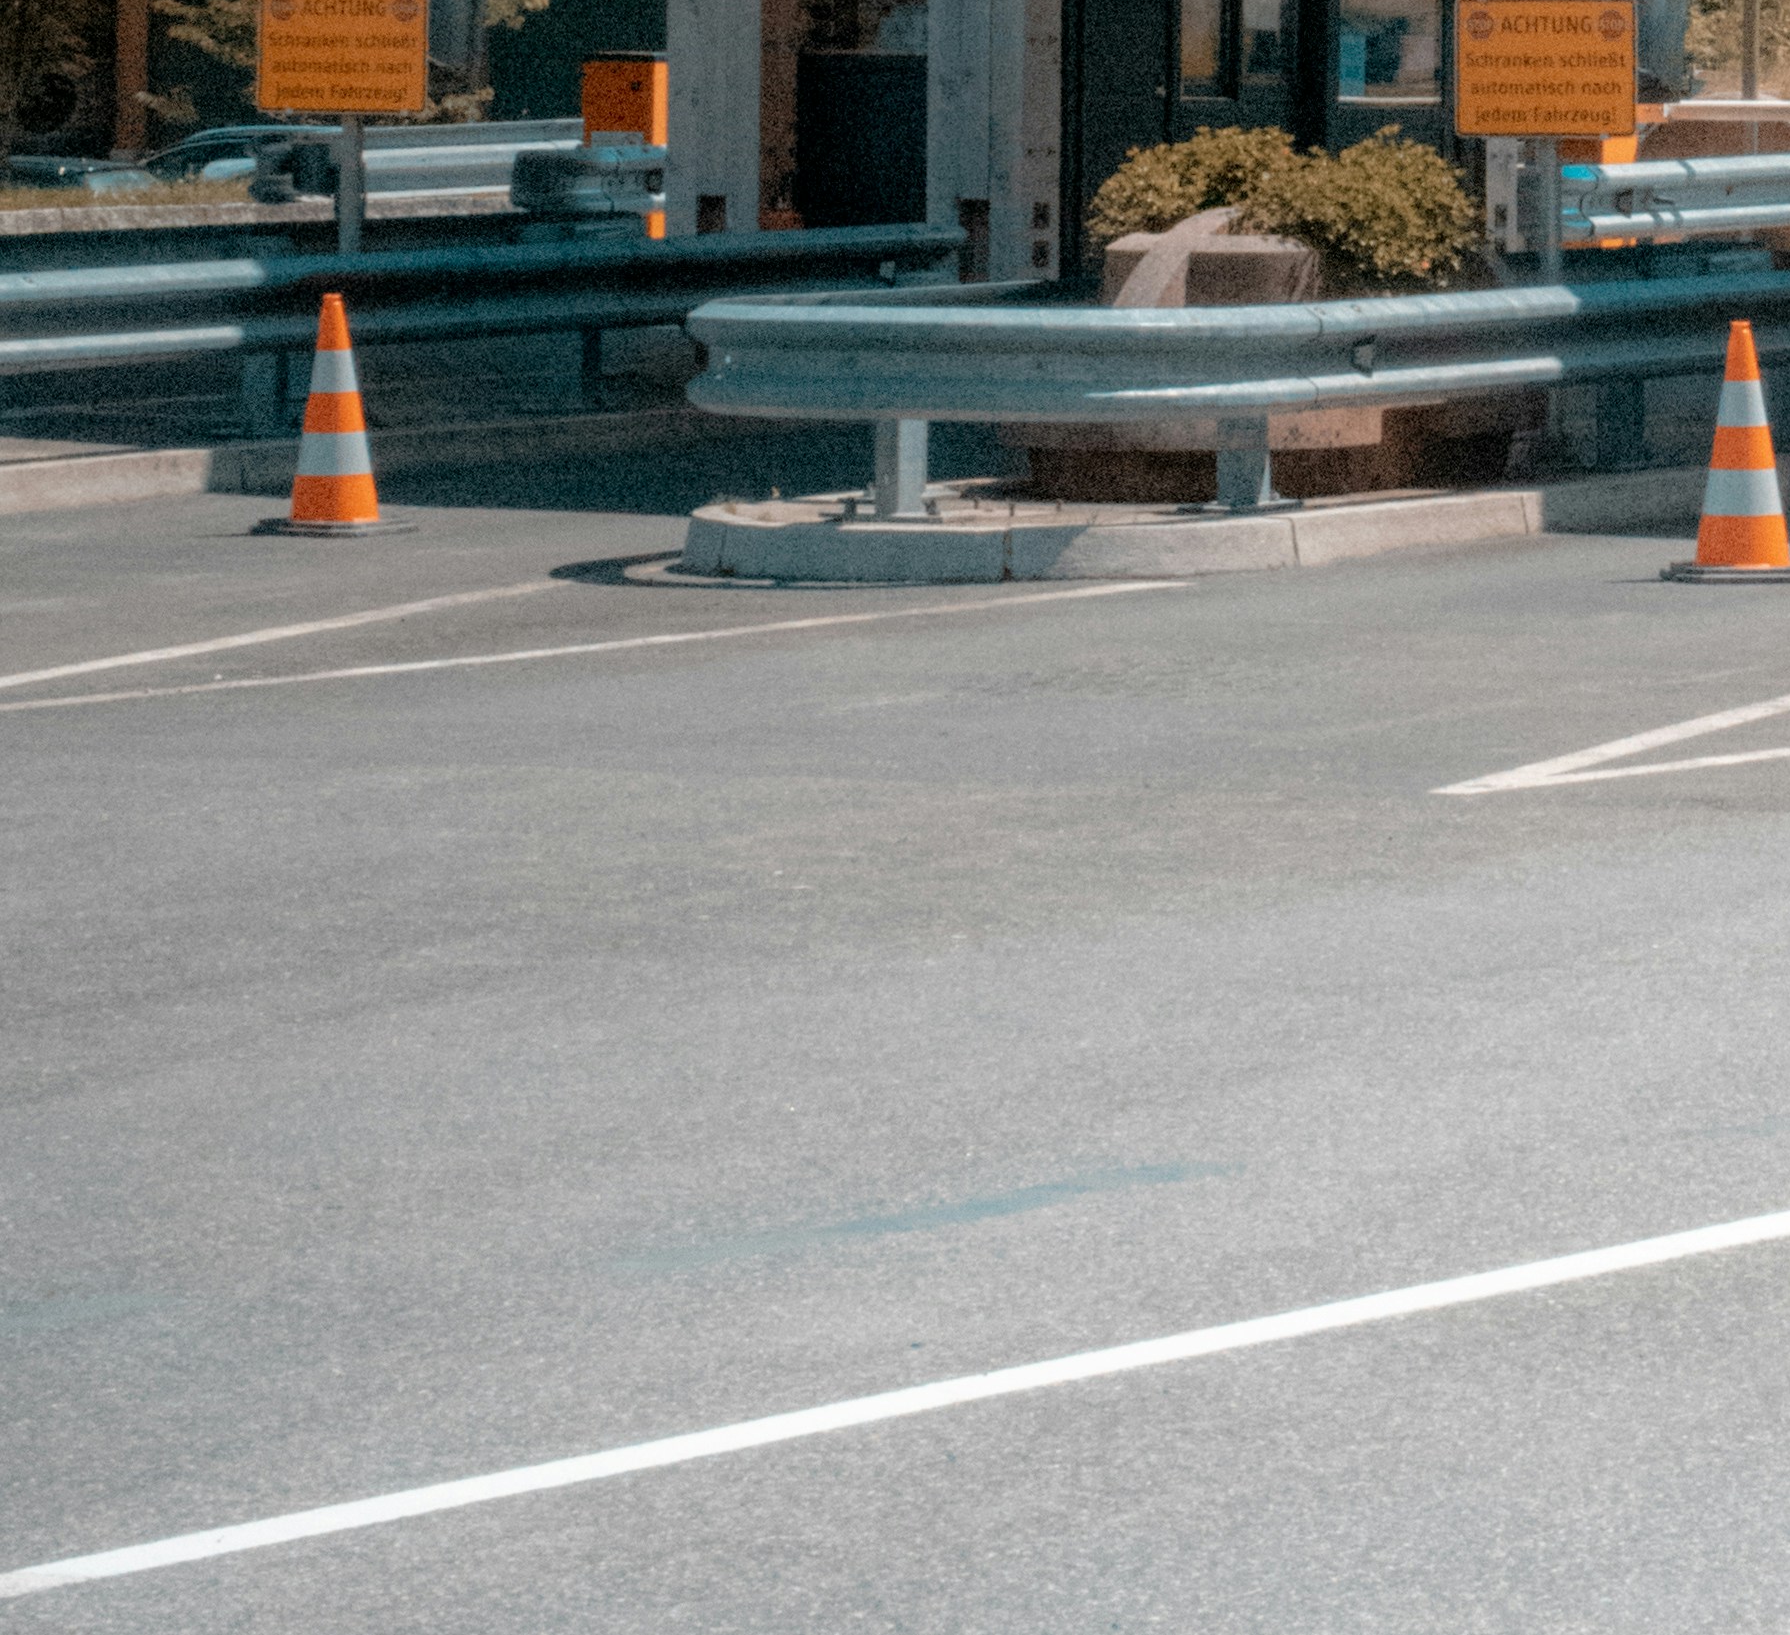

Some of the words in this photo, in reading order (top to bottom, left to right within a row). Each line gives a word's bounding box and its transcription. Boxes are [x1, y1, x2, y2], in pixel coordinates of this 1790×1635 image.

[301, 0, 387, 17] ACHTUNG
[1501, 15, 1593, 34] ACHTUNG
[1466, 51, 1554, 68] Schranken
[1559, 51, 1626, 68] schließt
[1470, 80, 1575, 95] automatisch
[1581, 80, 1622, 95] nach
[1474, 106, 1527, 125] jedem
[1533, 106, 1617, 125] Fahrzeug!
